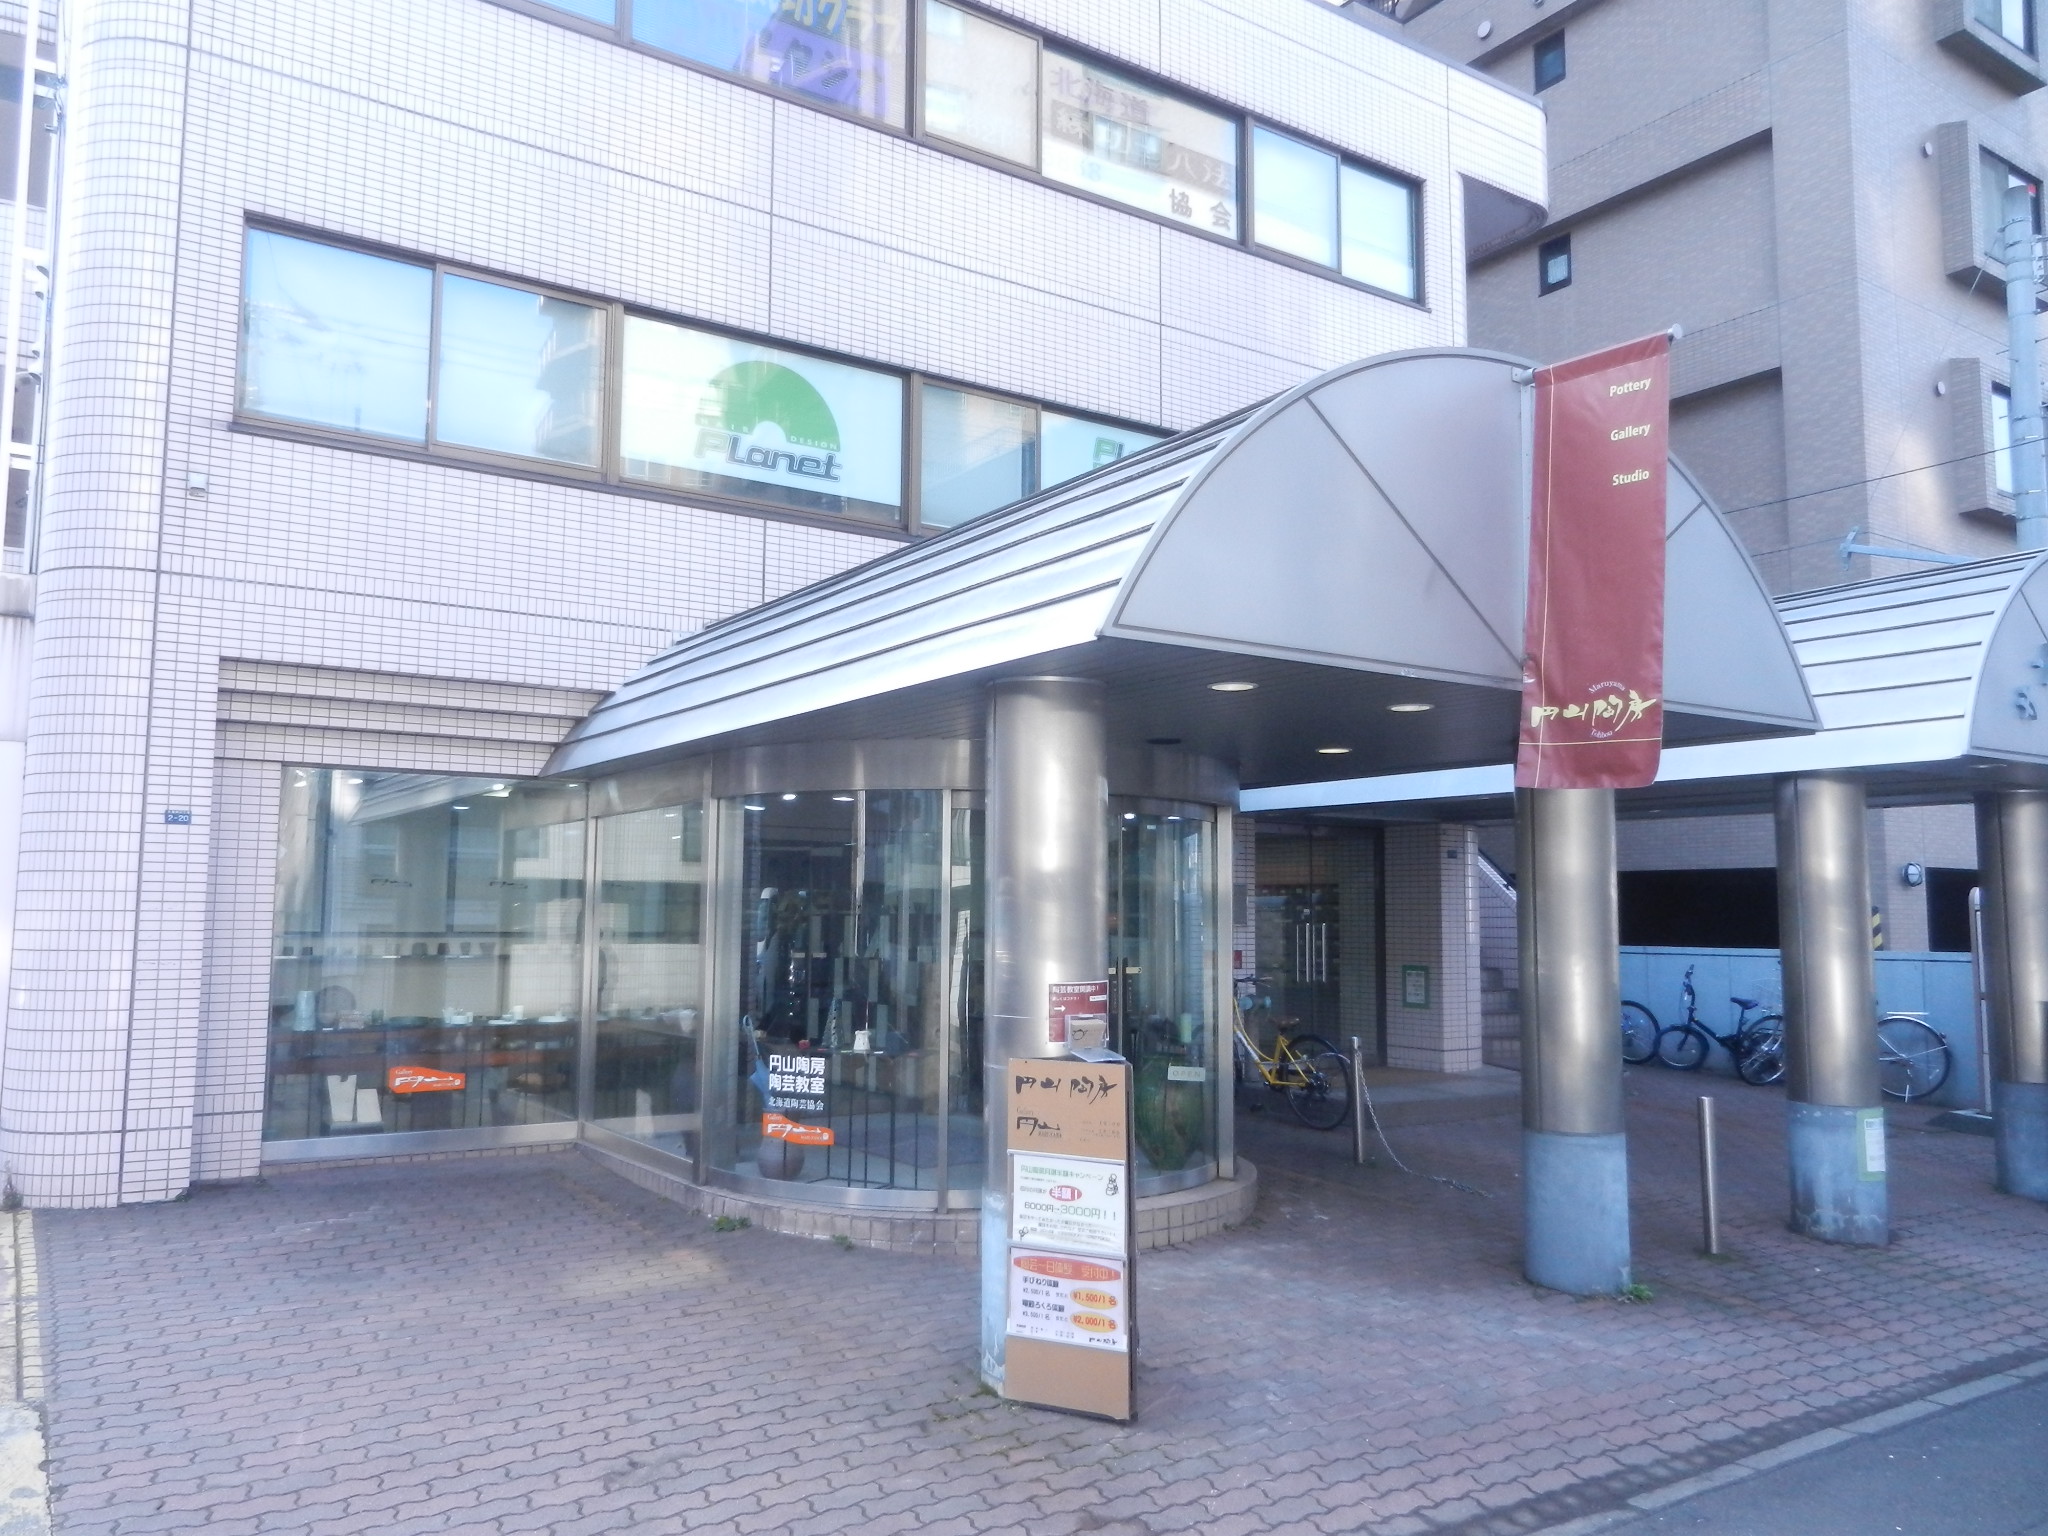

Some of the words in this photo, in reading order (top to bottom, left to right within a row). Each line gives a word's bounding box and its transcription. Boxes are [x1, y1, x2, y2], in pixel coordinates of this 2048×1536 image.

[1169, 188, 1232, 232] 協会
[1609, 378, 1652, 397] Pottery
[700, 417, 750, 433] HAIR
[790, 434, 838, 450] DESIGN
[1610, 424, 1651, 441] Gallery
[1612, 469, 1650, 486] Studio
[1588, 681, 1626, 694] Maruyama
[167, 814, 189, 822] 2-20
[768, 1054, 826, 1075] 円山陶房
[1173, 1070, 1201, 1078] OPEN
[768, 1073, 826, 1094] 陶芸教室
[1022, 1276, 1060, 1288] 手びねり体験
[1021, 1299, 1065, 1312] 電動ろくろ体験
